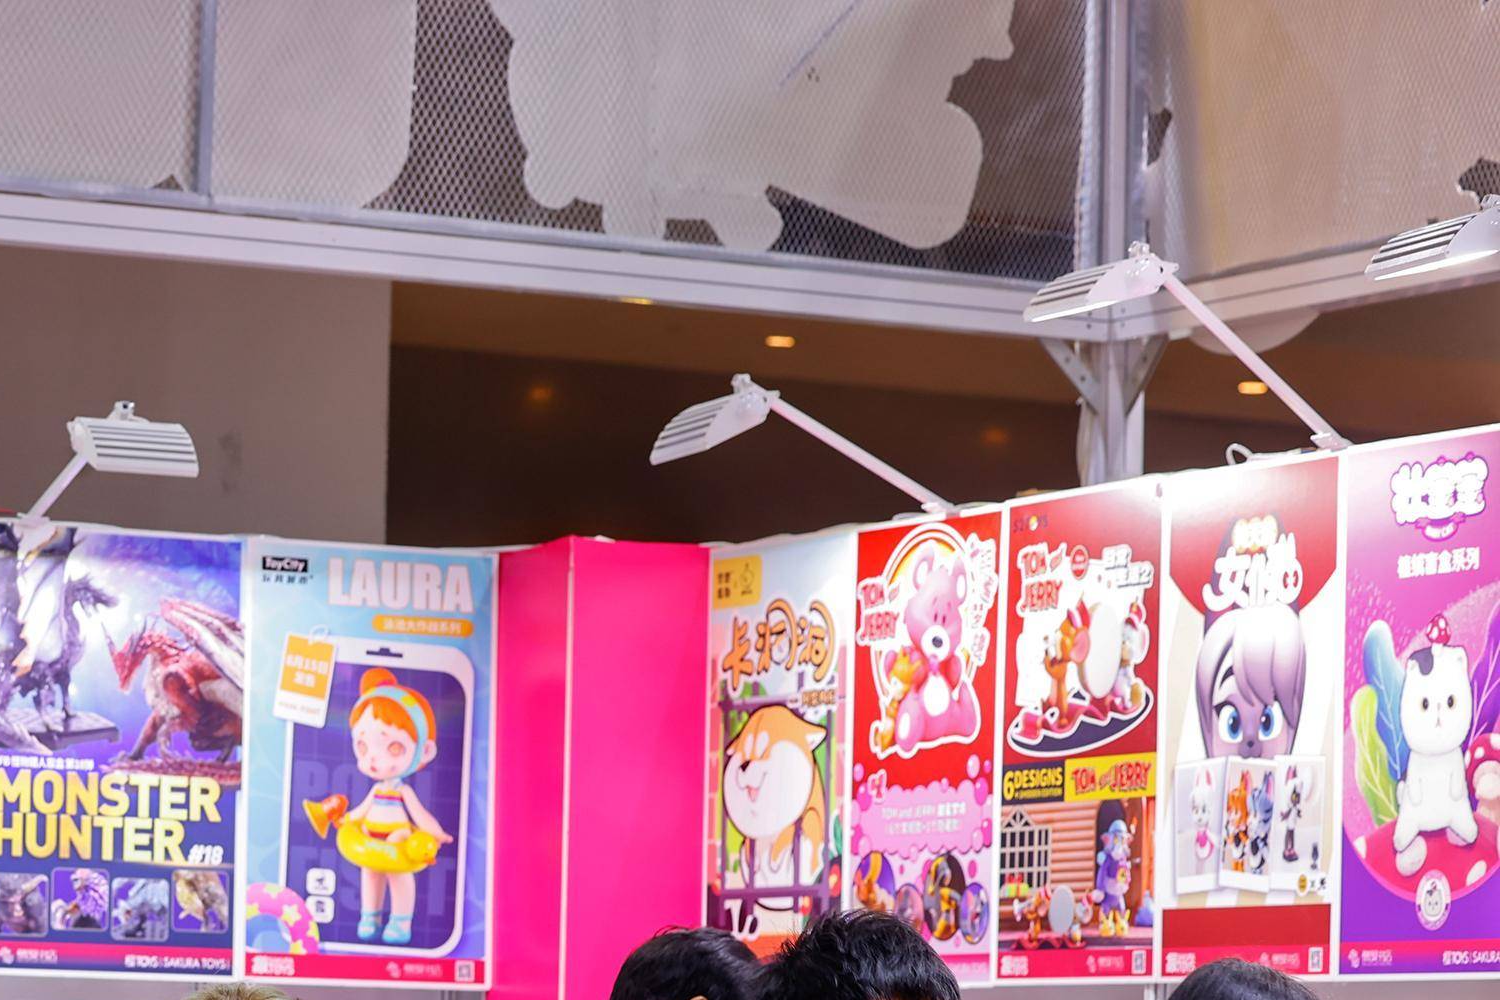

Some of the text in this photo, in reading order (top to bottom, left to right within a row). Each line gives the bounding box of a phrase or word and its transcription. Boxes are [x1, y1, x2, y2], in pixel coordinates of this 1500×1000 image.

[328, 557, 475, 614] LAURA
[861, 581, 886, 609] TOM
[1021, 581, 1064, 612] JERRY
[860, 611, 900, 641] JERRY
[1072, 766, 1097, 796] TOM
[1109, 760, 1153, 793] JERRY
[188, 844, 224, 866] #18
[164, 956, 201, 970] SAKURA
[202, 957, 228, 971] TOYS
